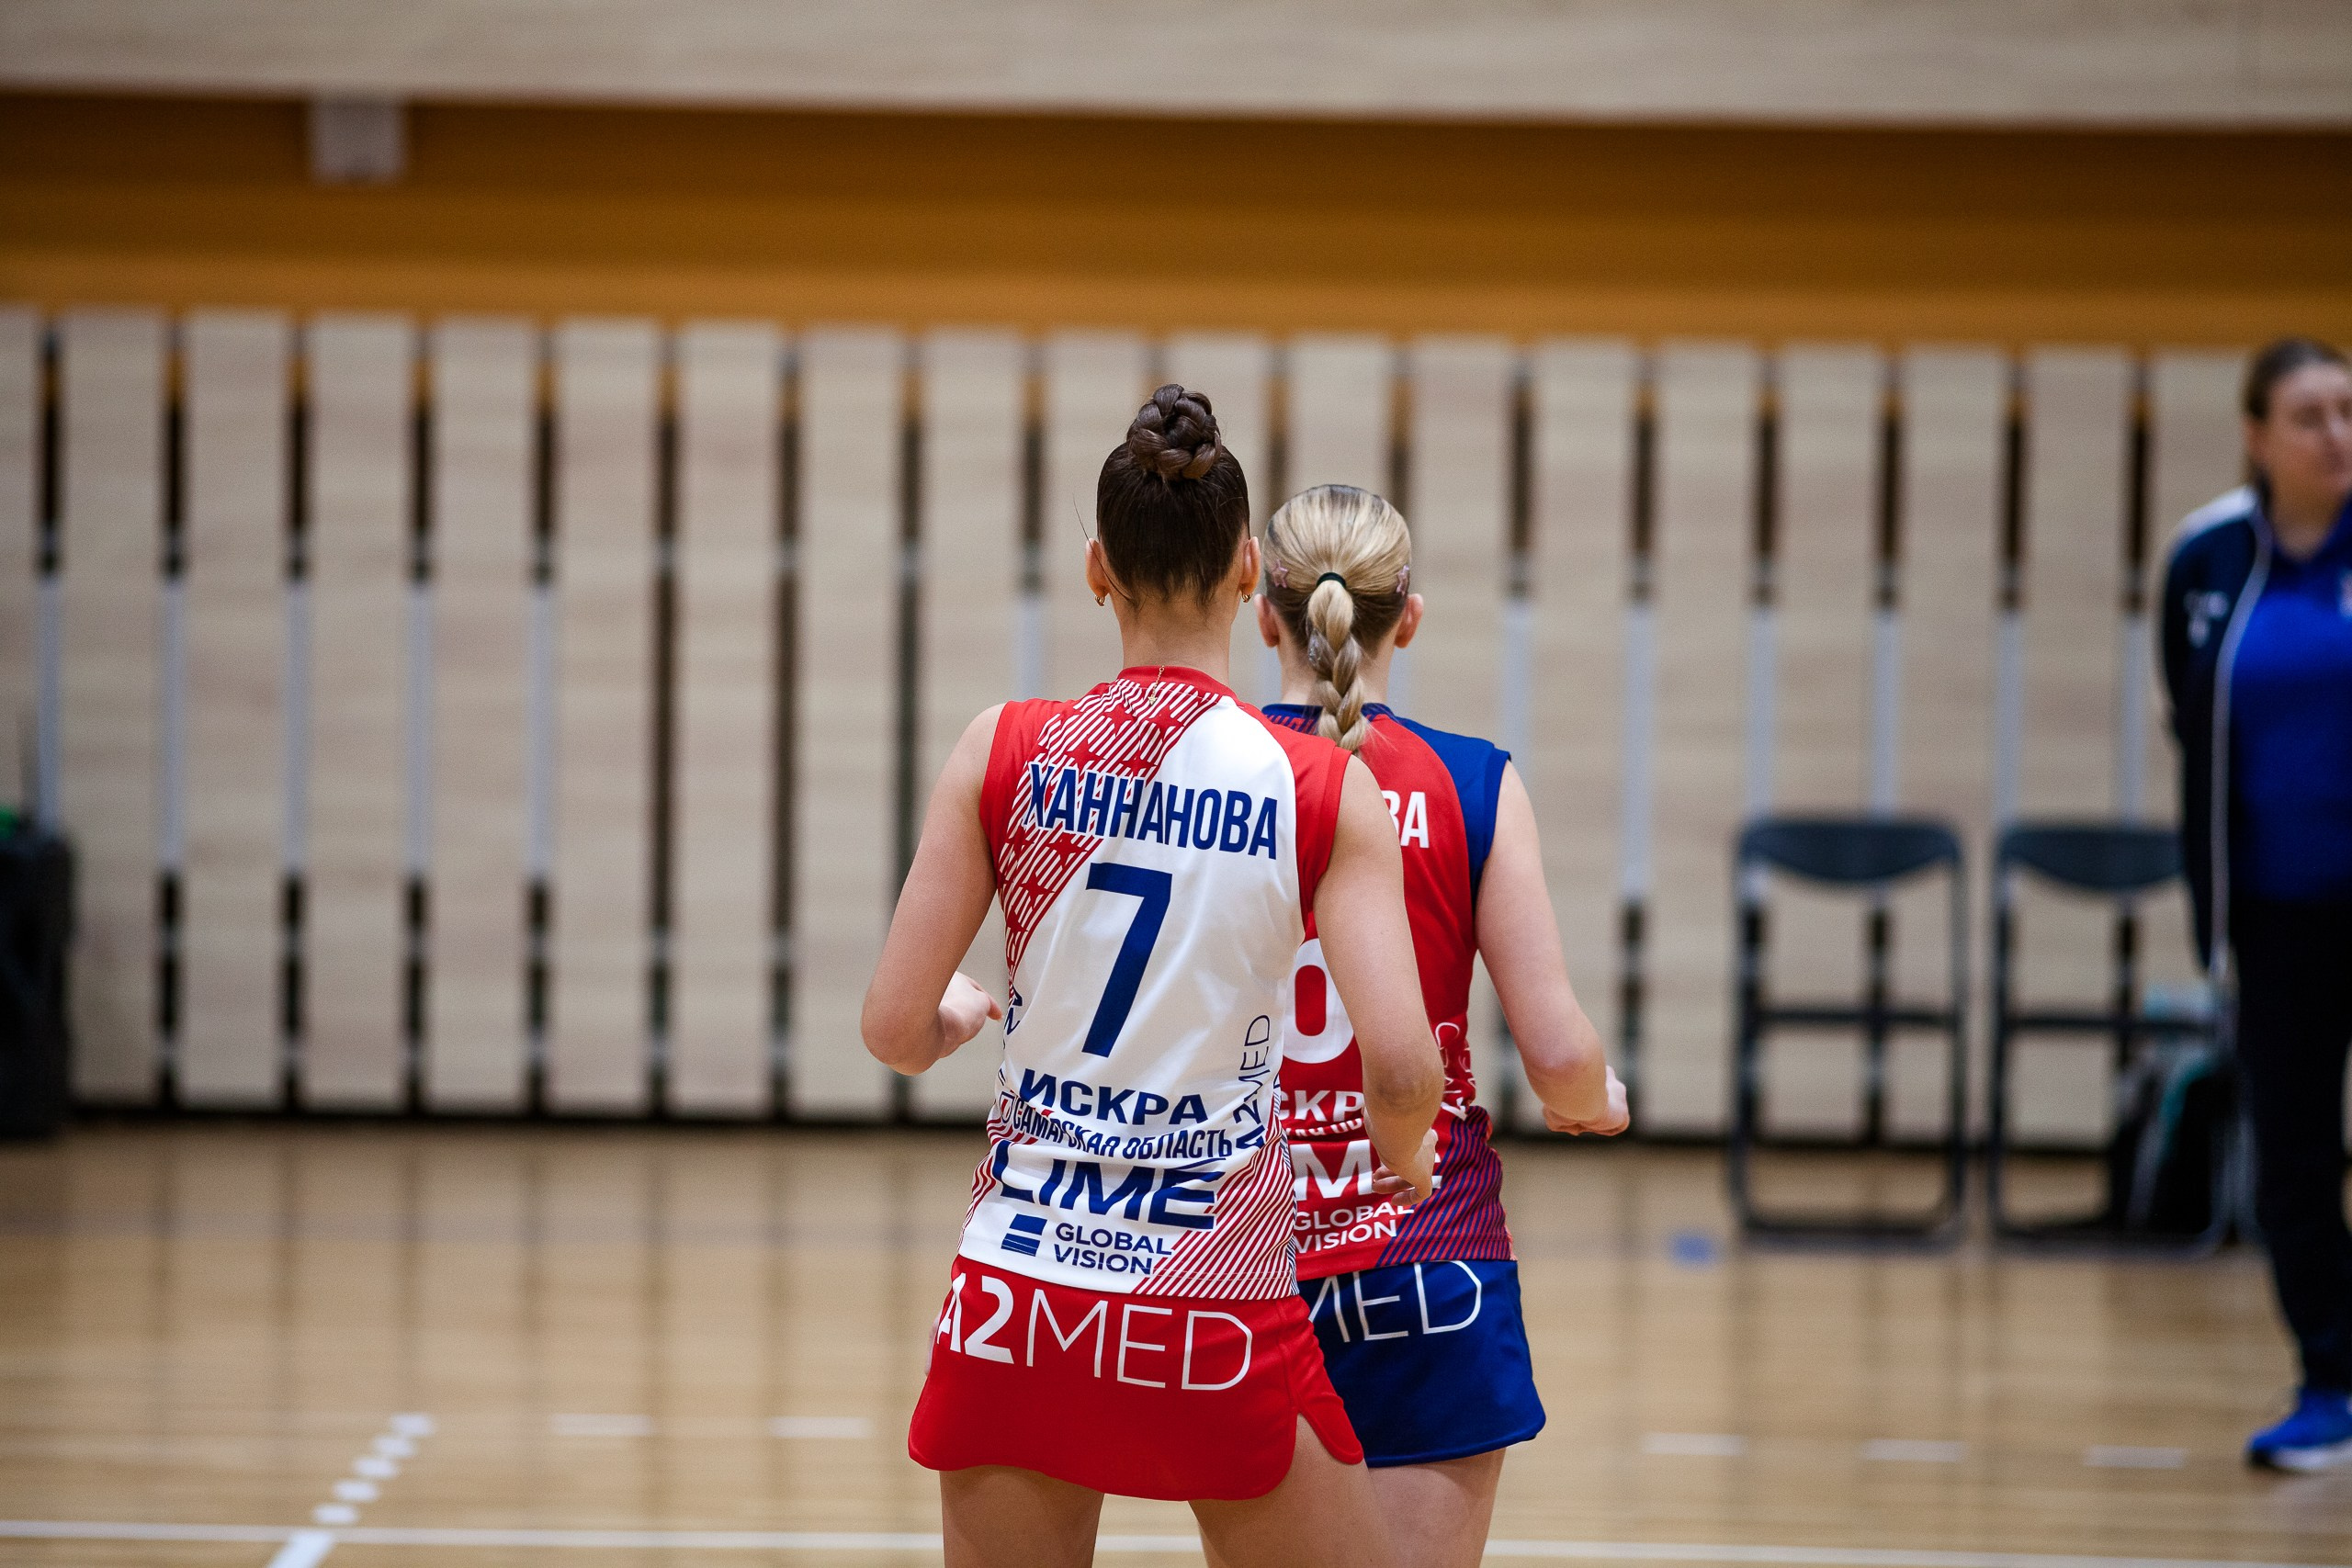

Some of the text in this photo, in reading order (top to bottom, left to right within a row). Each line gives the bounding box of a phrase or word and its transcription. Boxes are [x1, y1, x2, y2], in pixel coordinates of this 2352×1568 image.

[1023, 763, 1277, 860] ХАННАНОВА
[1081, 862, 1172, 1058] 7
[1019, 1067, 1208, 1125] ИСКРА
[1122, 1129, 1233, 1160] ОБЛАСТЬ
[992, 1140, 1226, 1230] LIME
[1054, 1244, 1153, 1275] VISION
[1056, 1222, 1172, 1256] GLOBAL
[1295, 1219, 1397, 1254] VISION
[936, 1271, 1252, 1392] A2MED
